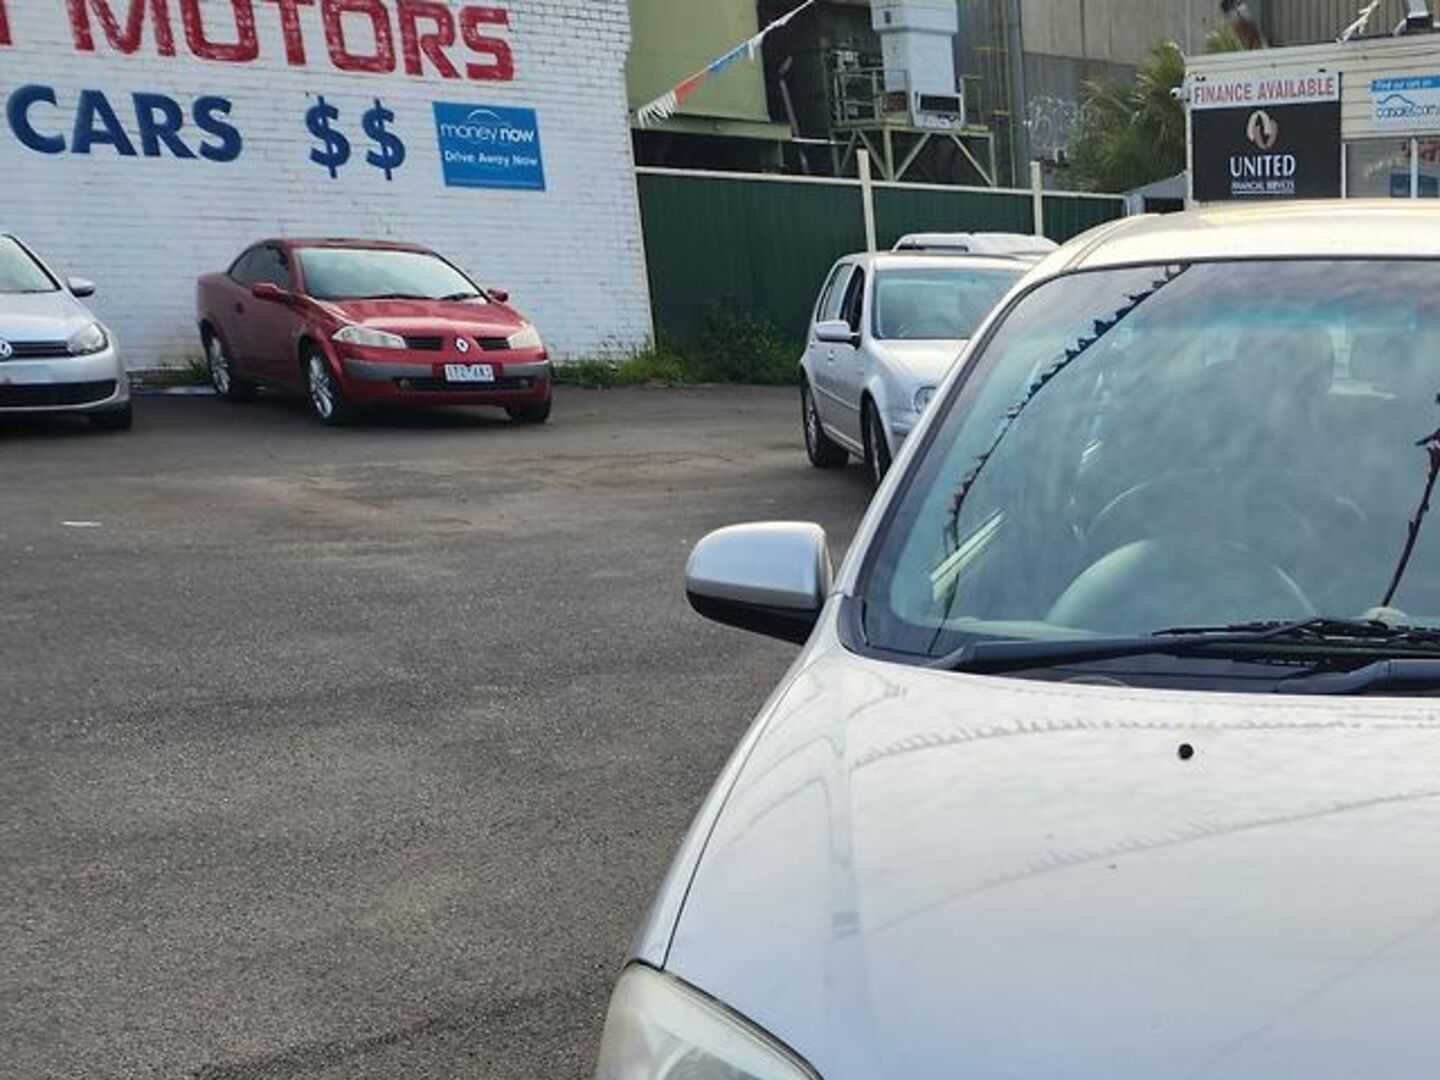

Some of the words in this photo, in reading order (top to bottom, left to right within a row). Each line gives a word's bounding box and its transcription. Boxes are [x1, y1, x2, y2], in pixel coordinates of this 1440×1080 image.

[66, 0, 514, 81] MOTORS
[1193, 82, 1253, 103] FINANCE
[1257, 76, 1336, 100] AVAILABLE
[6, 84, 242, 163] CARS
[444, 150, 476, 163] Drive
[1230, 154, 1296, 177] UNITED
